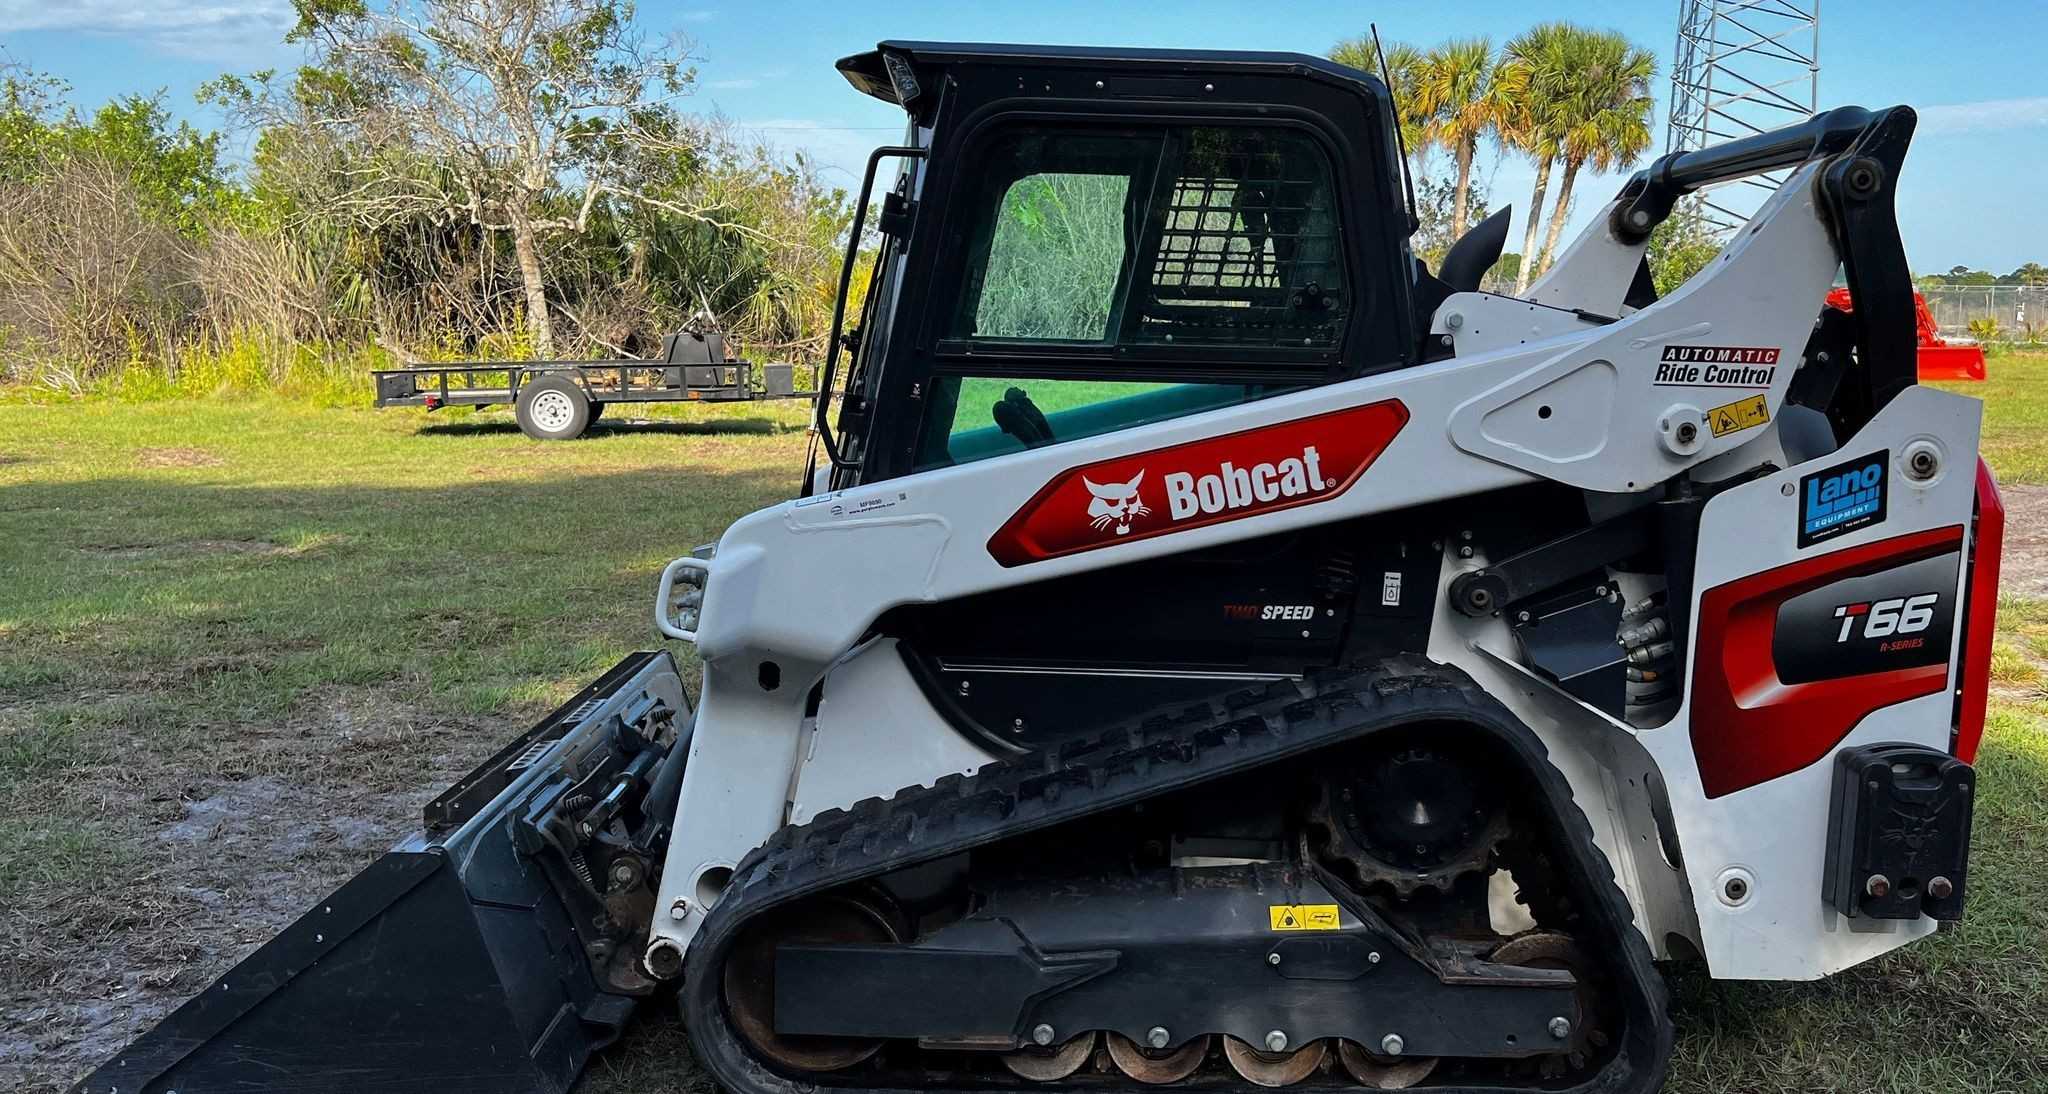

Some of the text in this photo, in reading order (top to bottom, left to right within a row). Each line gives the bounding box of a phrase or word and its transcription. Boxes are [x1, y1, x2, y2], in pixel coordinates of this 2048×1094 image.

[1665, 348, 1776, 363] AUTOMATIC
[1655, 363, 1776, 385] Ride Control
[1164, 446, 1325, 521] Bobcat
[1806, 463, 1883, 519] Lano
[1815, 503, 1870, 528] EQUIPMENT
[1223, 604, 1315, 620] TWO SPEED
[1834, 593, 1939, 643] T66
[1880, 639, 1925, 653] R-SERIES
